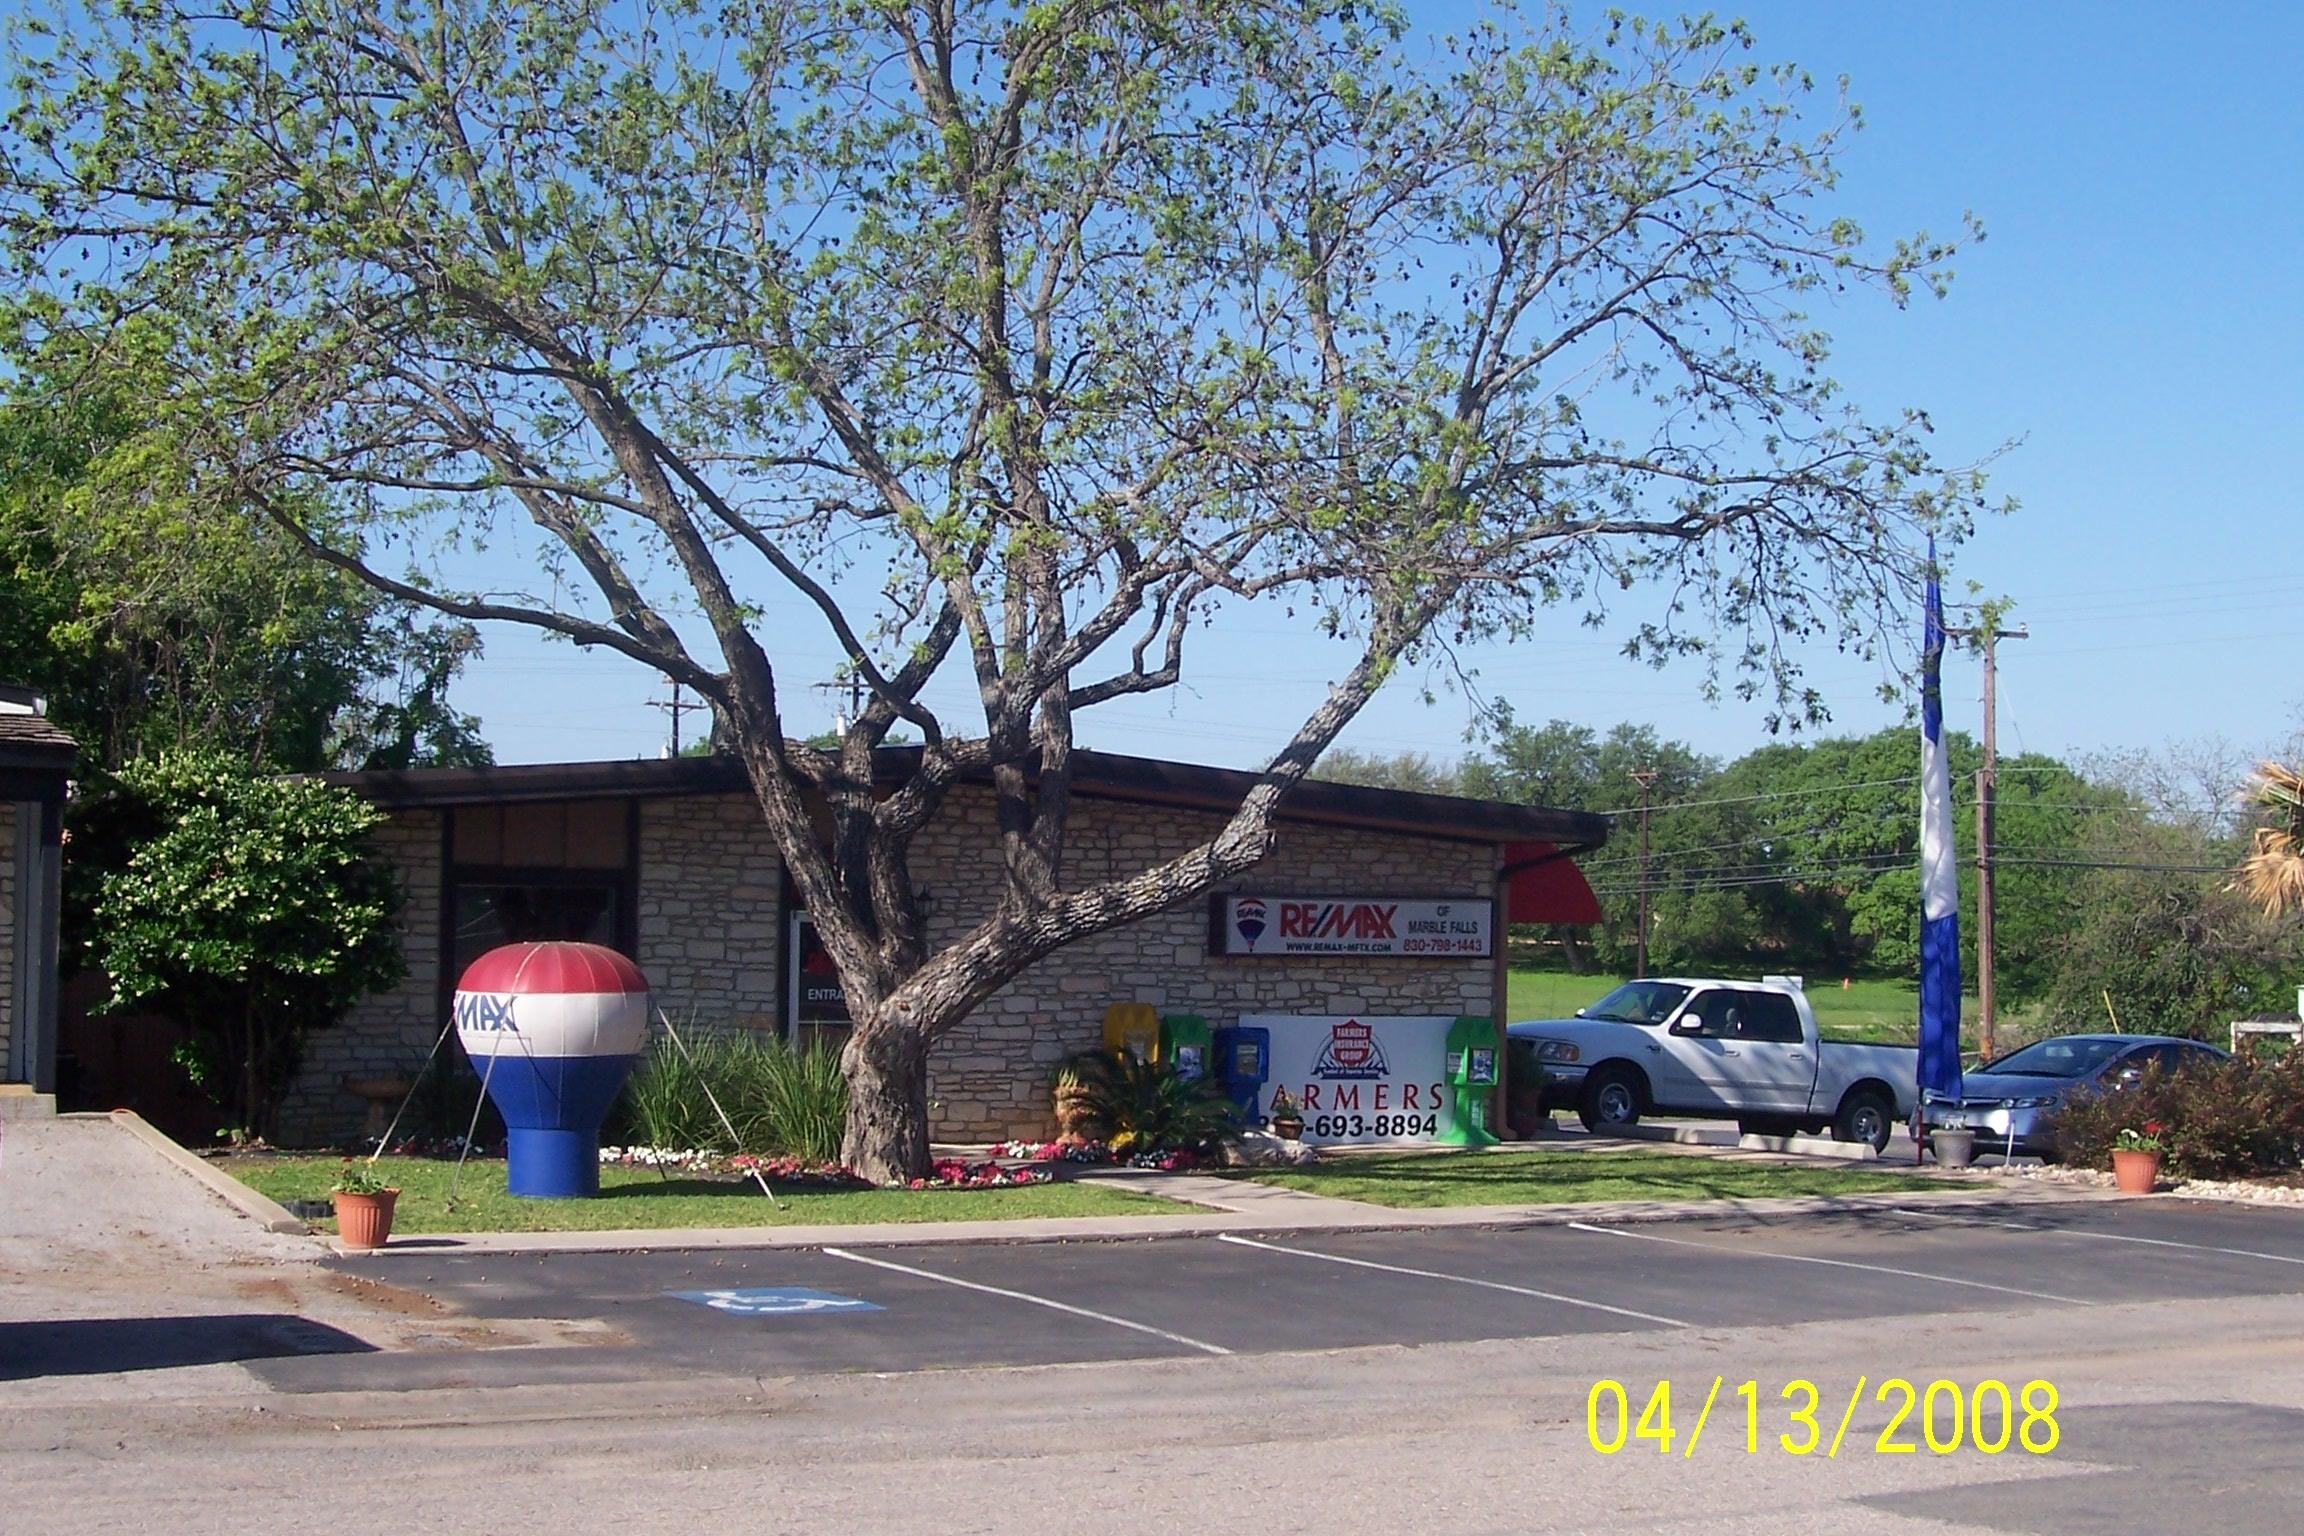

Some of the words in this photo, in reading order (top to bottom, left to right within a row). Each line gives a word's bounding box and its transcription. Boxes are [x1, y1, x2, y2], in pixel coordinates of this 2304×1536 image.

[1280, 903, 1398, 938] RE/MAX
[1437, 905, 1451, 917] OF
[1408, 921, 1447, 934] MARBLE
[1450, 921, 1478, 934] FALLS
[808, 988, 844, 1000] ENTRA
[456, 992, 519, 1032] MAX
[1270, 1083, 1444, 1110] ARMERS
[1258, 1114, 1438, 1137] -693-8894
